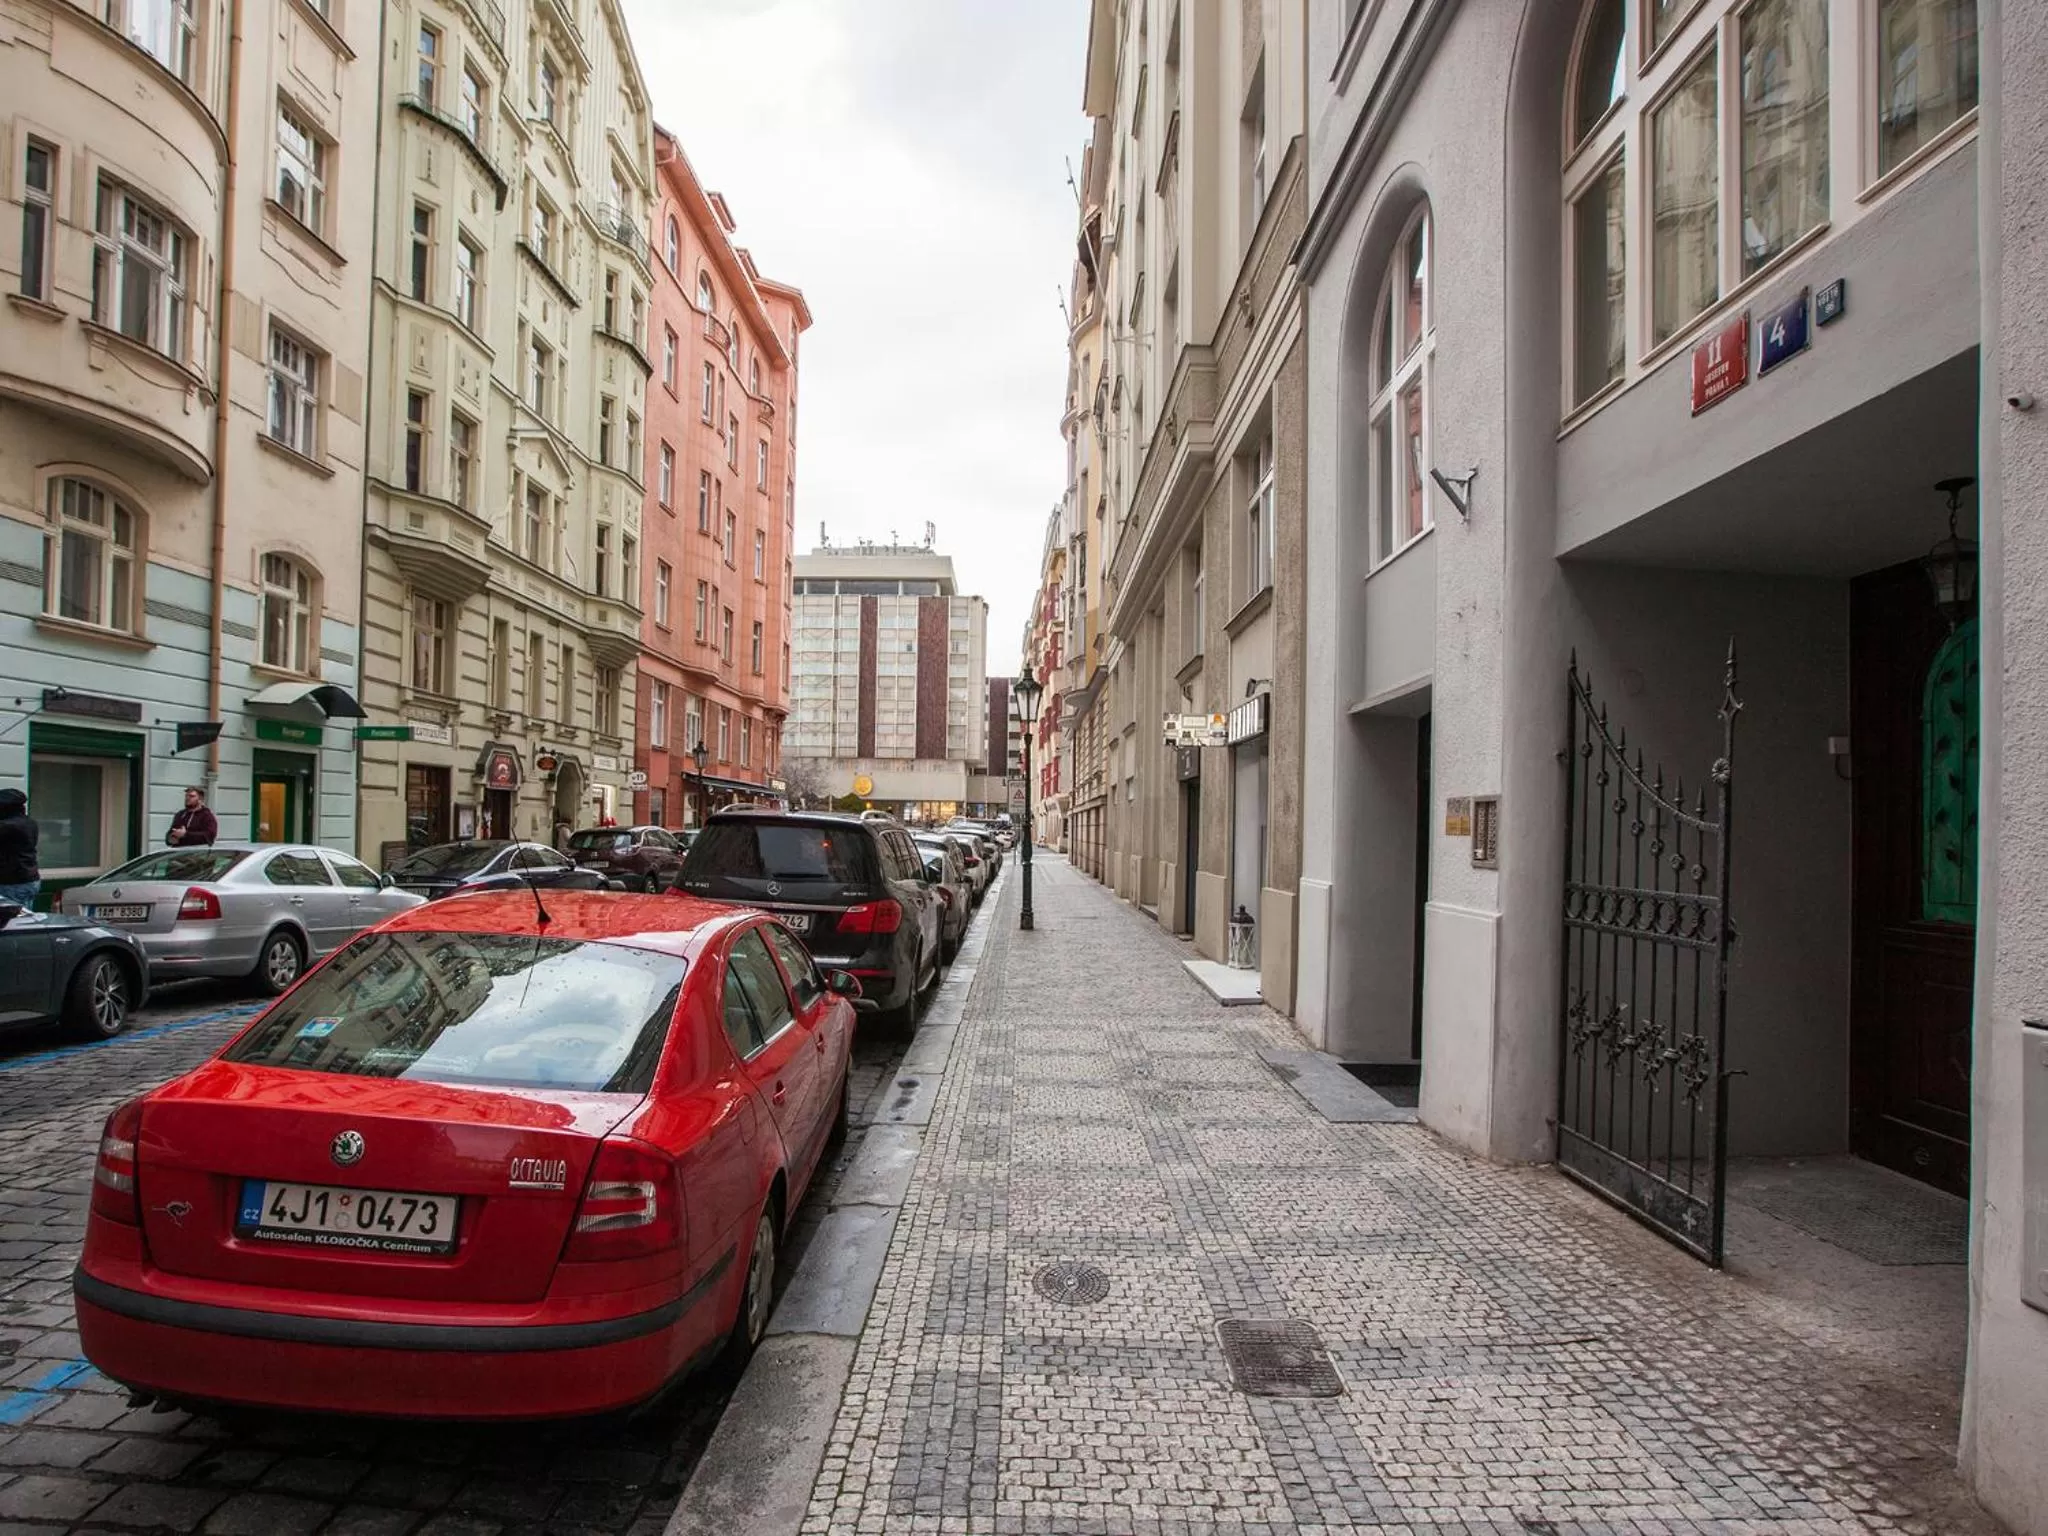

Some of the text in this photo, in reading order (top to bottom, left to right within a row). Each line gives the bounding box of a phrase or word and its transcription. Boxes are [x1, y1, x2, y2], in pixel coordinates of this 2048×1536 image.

[1770, 315, 1785, 346] 4
[510, 1158, 568, 1182] OCTAVIA
[243, 1208, 260, 1221] CZ
[269, 1187, 440, 1236] 4J1 0473
[254, 1229, 432, 1254] Autosalon KLOKOČKA Centrum
